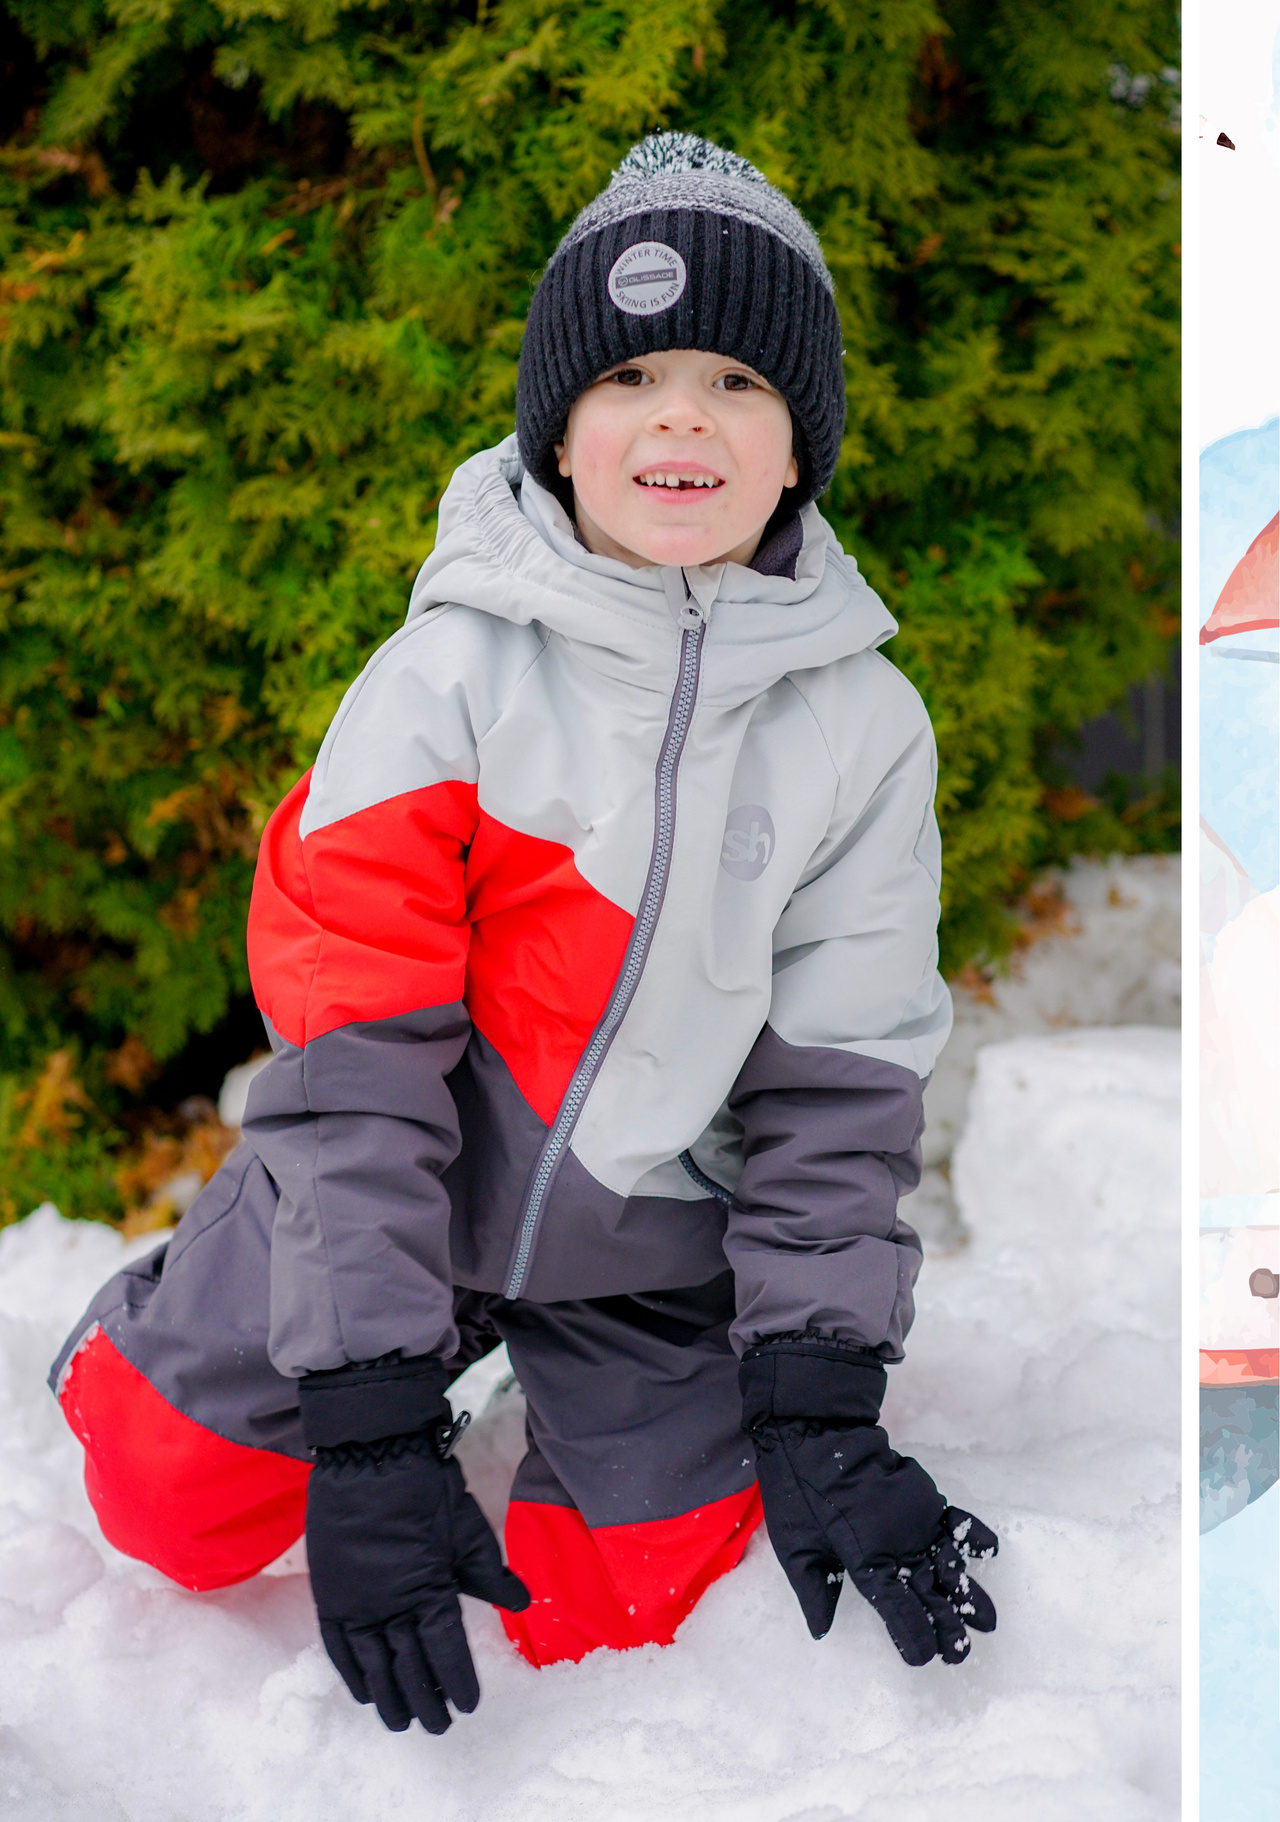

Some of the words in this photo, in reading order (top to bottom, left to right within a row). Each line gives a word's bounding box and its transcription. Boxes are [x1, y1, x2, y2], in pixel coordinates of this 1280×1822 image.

[615, 249, 651, 275] WINTER
[654, 249, 678, 267] TIME
[628, 271, 674, 284] GLISSADE
[616, 290, 647, 309] SKIING
[650, 297, 660, 308] IS
[661, 282, 680, 302] FUN
